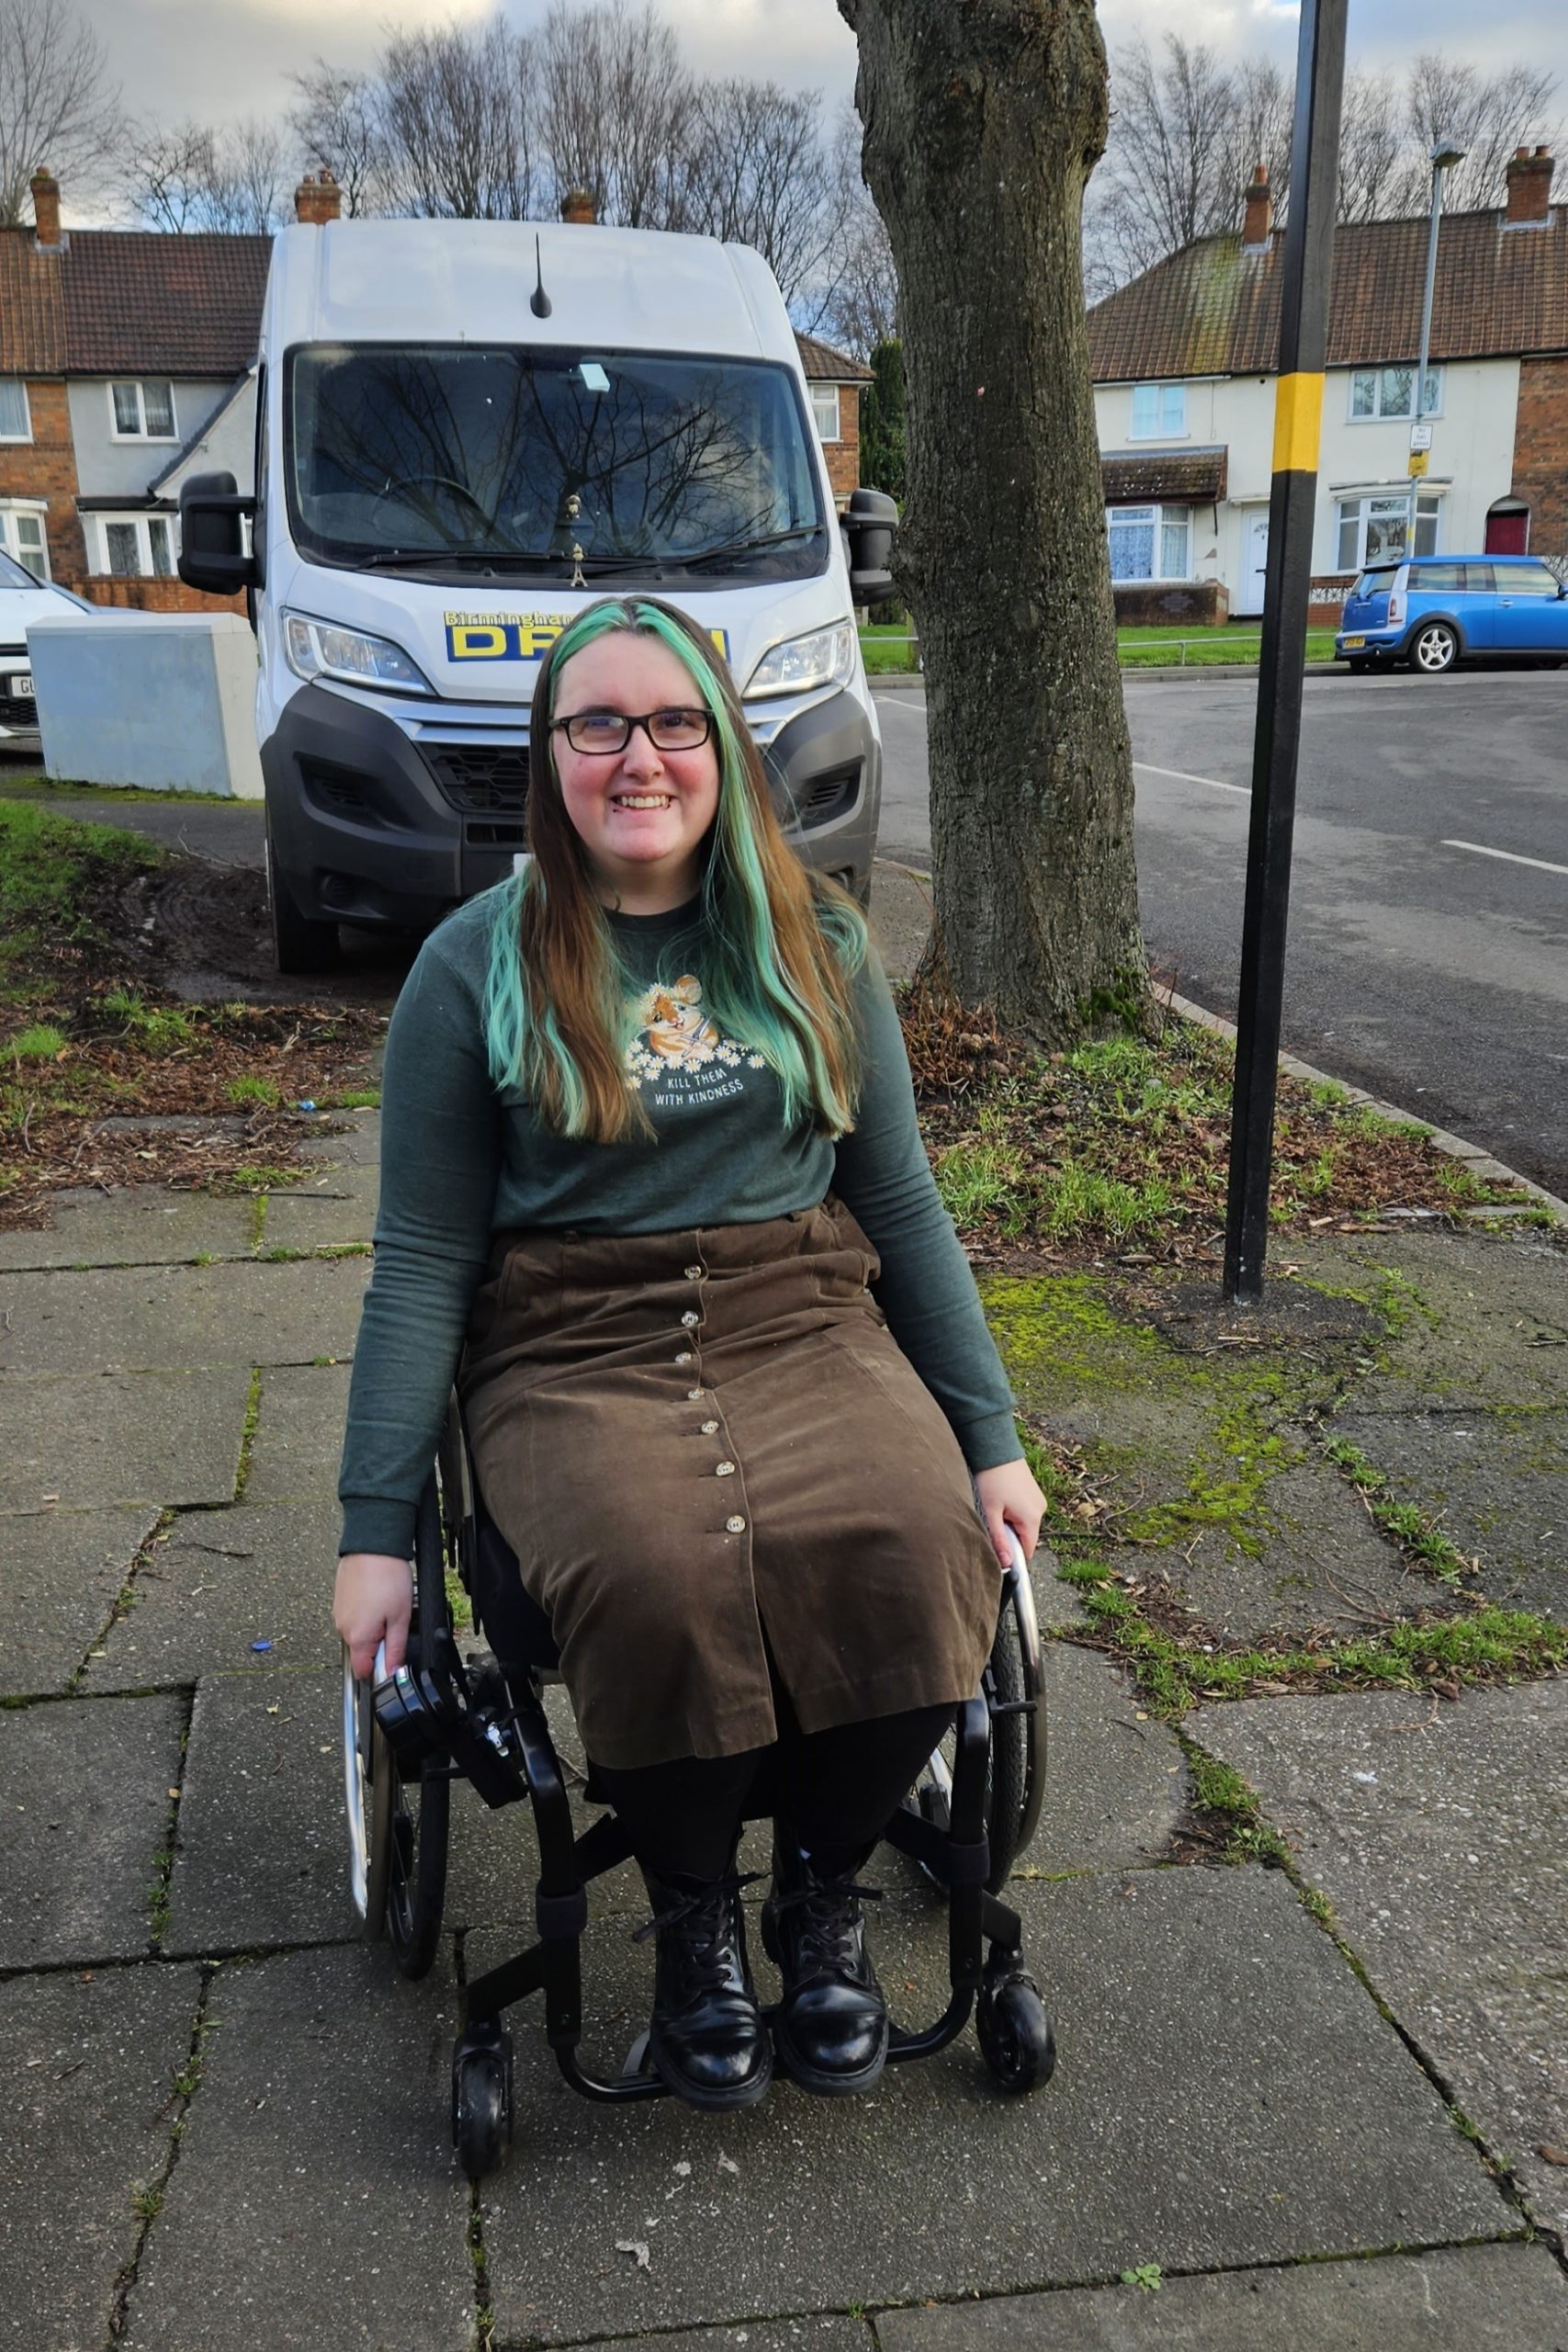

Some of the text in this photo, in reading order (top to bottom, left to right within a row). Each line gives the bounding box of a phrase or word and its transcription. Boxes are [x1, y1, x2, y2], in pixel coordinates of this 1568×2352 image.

[668, 1068, 728, 1089] KILL THEM
[655, 1079, 744, 1105] WITH KINDNESS
